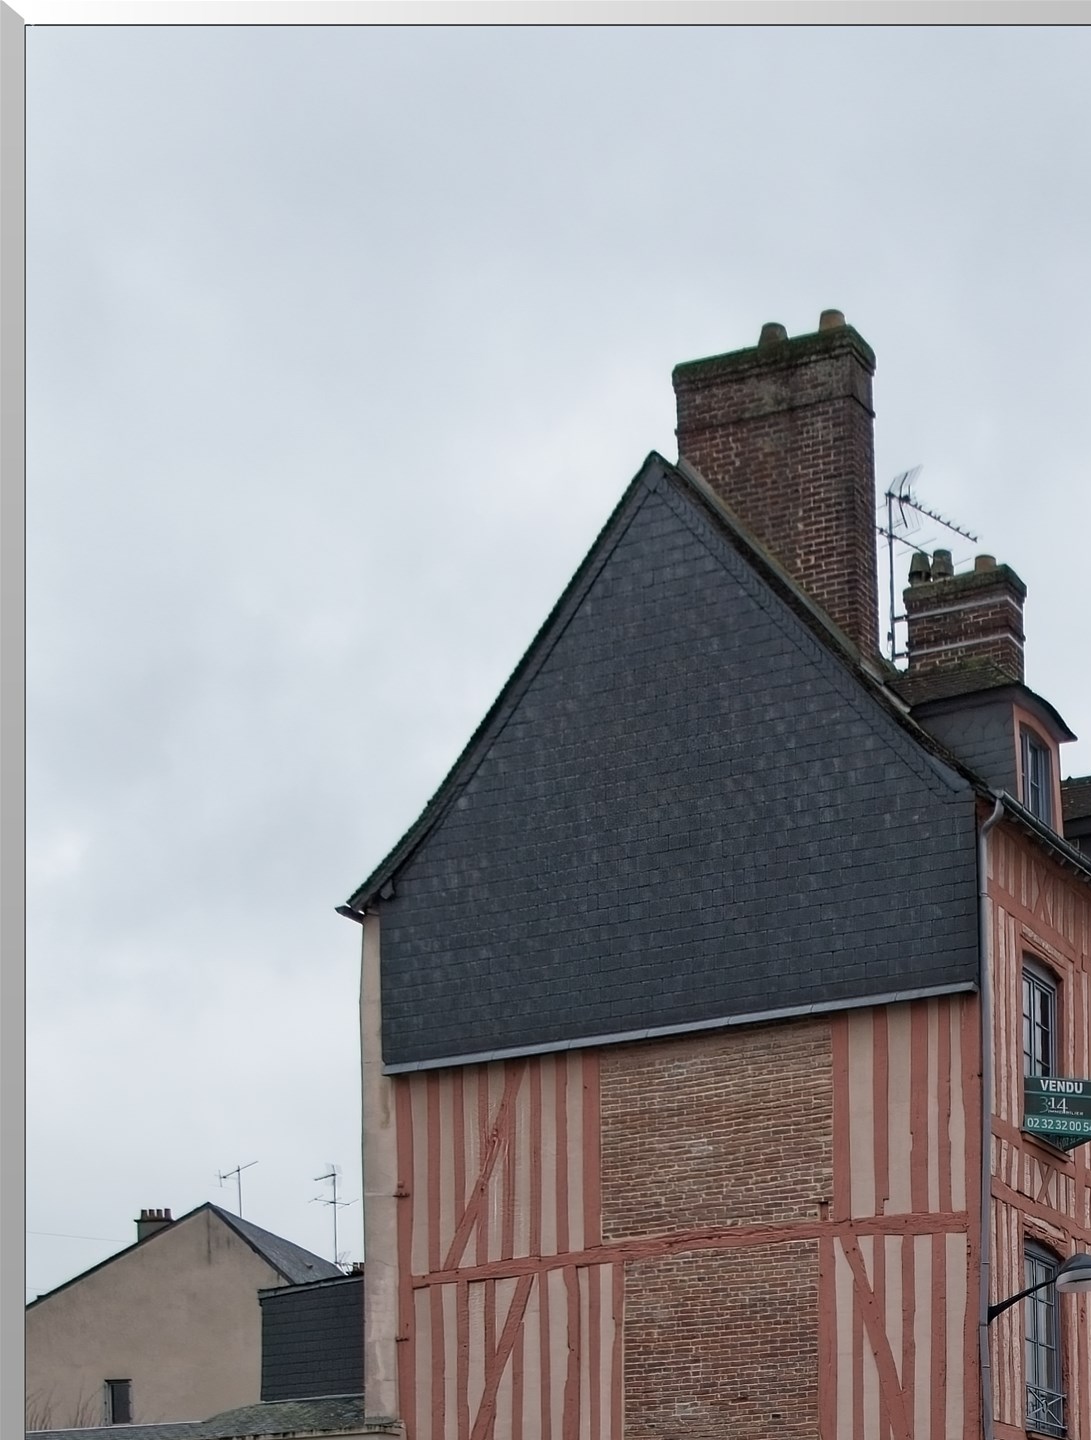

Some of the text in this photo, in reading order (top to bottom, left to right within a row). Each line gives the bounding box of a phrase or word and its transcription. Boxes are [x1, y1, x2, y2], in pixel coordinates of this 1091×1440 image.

[1040, 1079, 1083, 1094] VENDU
[1027, 1117, 1040, 1128] 02
[1041, 1118, 1054, 1130] 32
[1055, 1119, 1068, 1131] 32
[1069, 1120, 1082, 1132] 00
